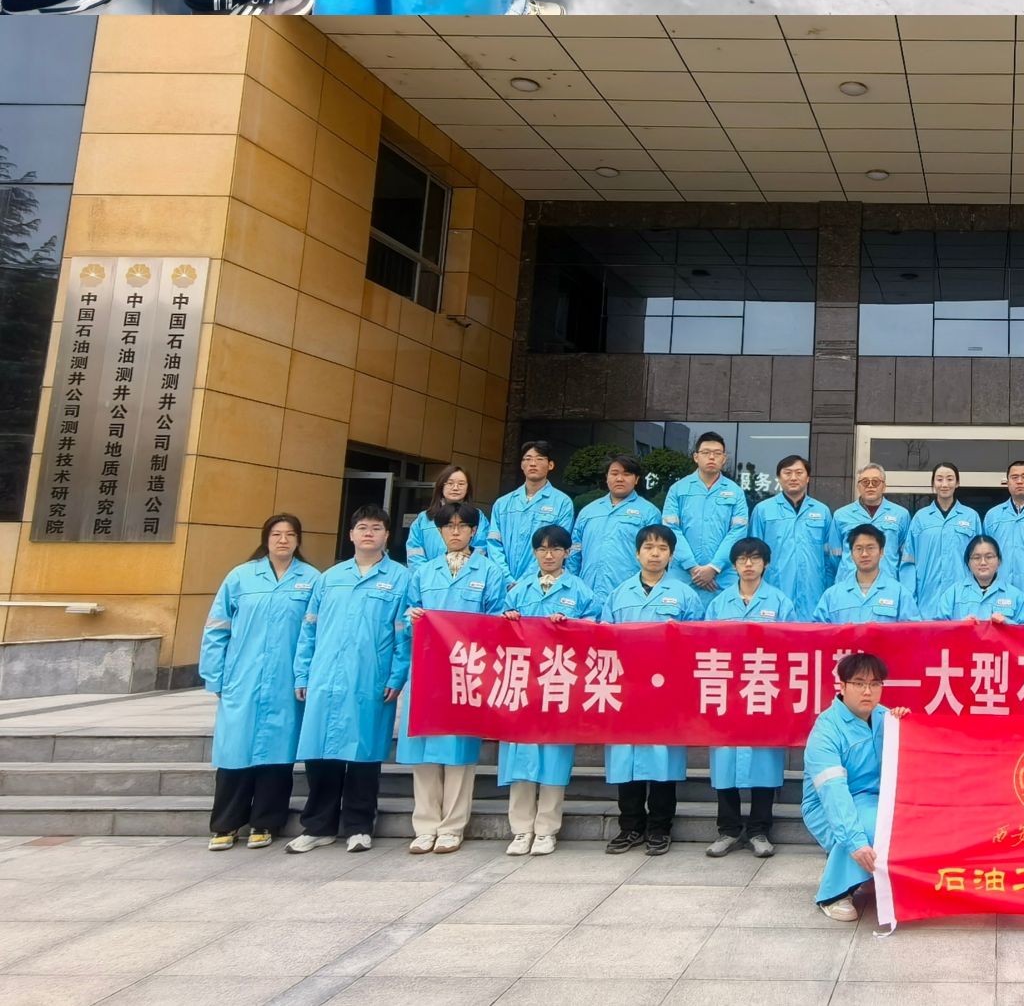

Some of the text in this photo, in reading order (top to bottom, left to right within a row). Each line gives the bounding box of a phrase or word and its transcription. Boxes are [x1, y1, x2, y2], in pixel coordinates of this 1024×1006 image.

[45, 292, 98, 535] 中国石油测井公司测井技术研究院
[92, 292, 144, 535] 中国石油测井公司地质研究院
[142, 293, 190, 535] 中国石油测井公司制造公司
